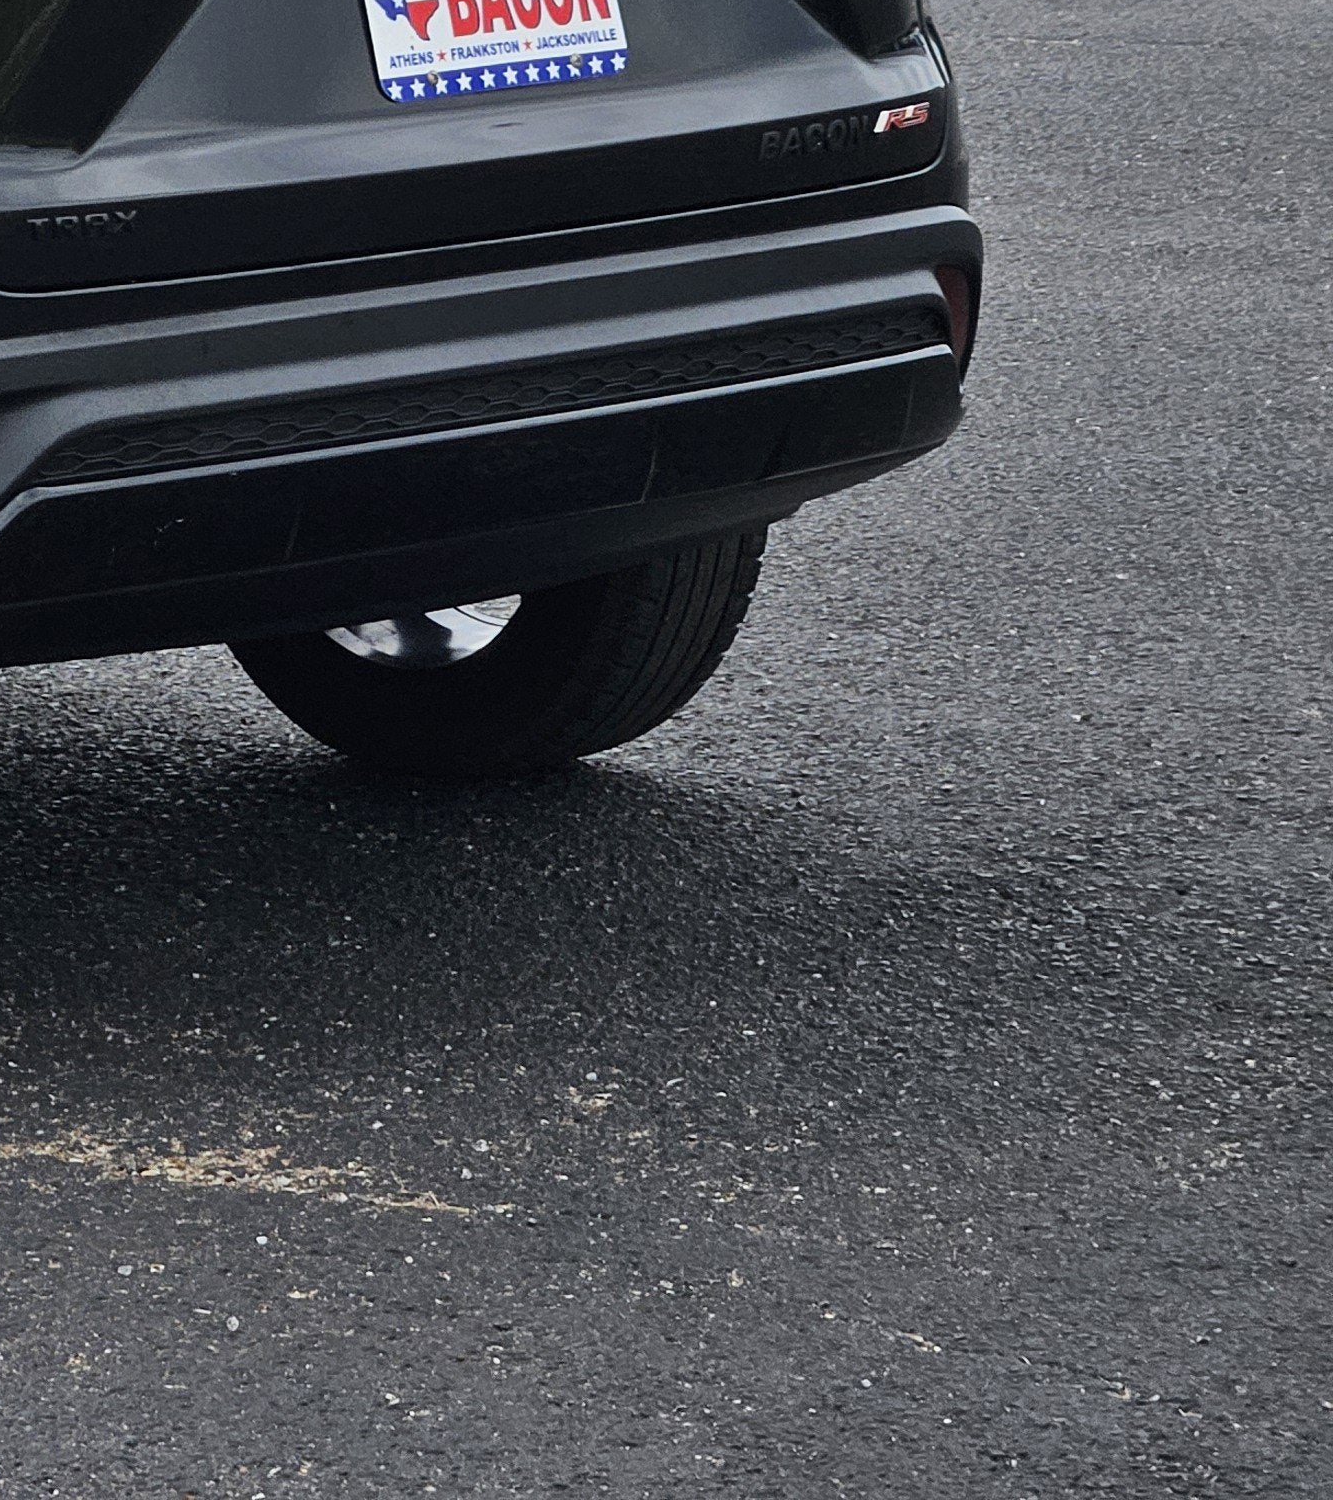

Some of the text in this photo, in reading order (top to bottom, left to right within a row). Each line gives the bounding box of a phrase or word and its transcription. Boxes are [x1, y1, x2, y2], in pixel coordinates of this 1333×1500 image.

[389, 28, 618, 69] ATHENS FRANKSTON JACKSONVILLE
[874, 102, 930, 134] RS
